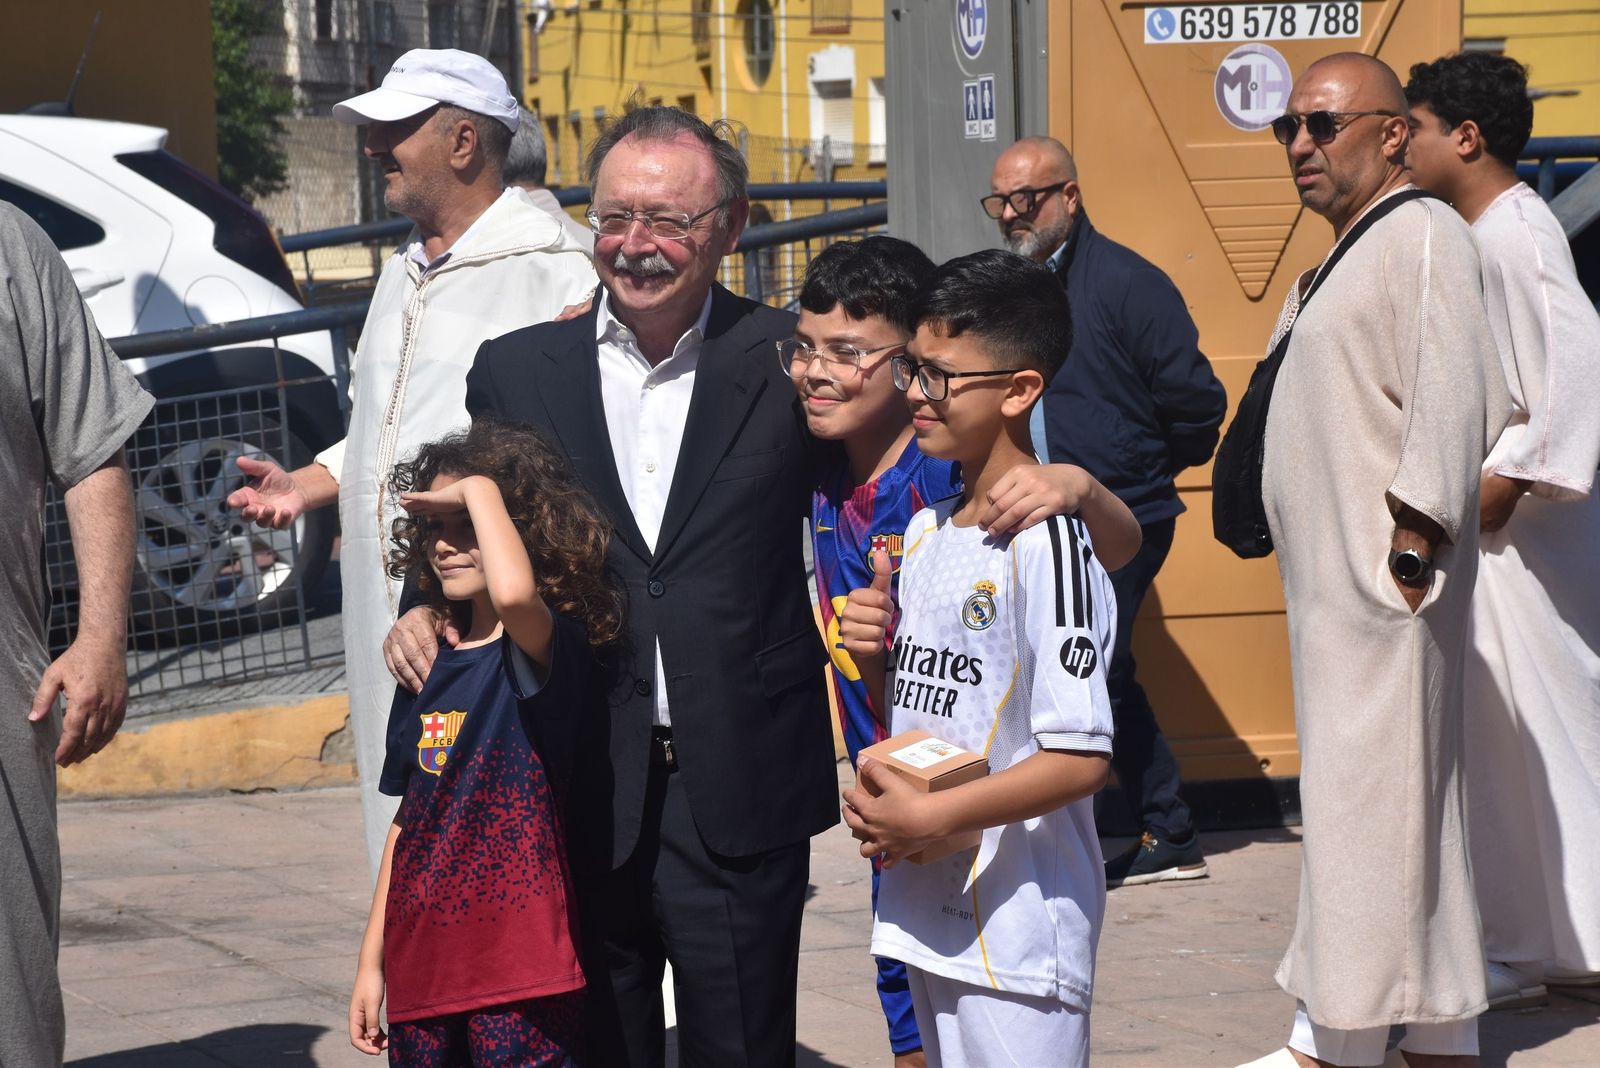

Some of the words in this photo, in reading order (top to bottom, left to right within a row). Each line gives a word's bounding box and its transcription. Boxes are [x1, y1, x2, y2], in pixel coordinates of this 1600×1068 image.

[1180, 8, 1234, 40] 639
[1243, 5, 1296, 38] 578
[1306, 3, 1359, 36] 788
[1065, 636, 1094, 679] hp
[893, 678, 959, 718] BETTER
